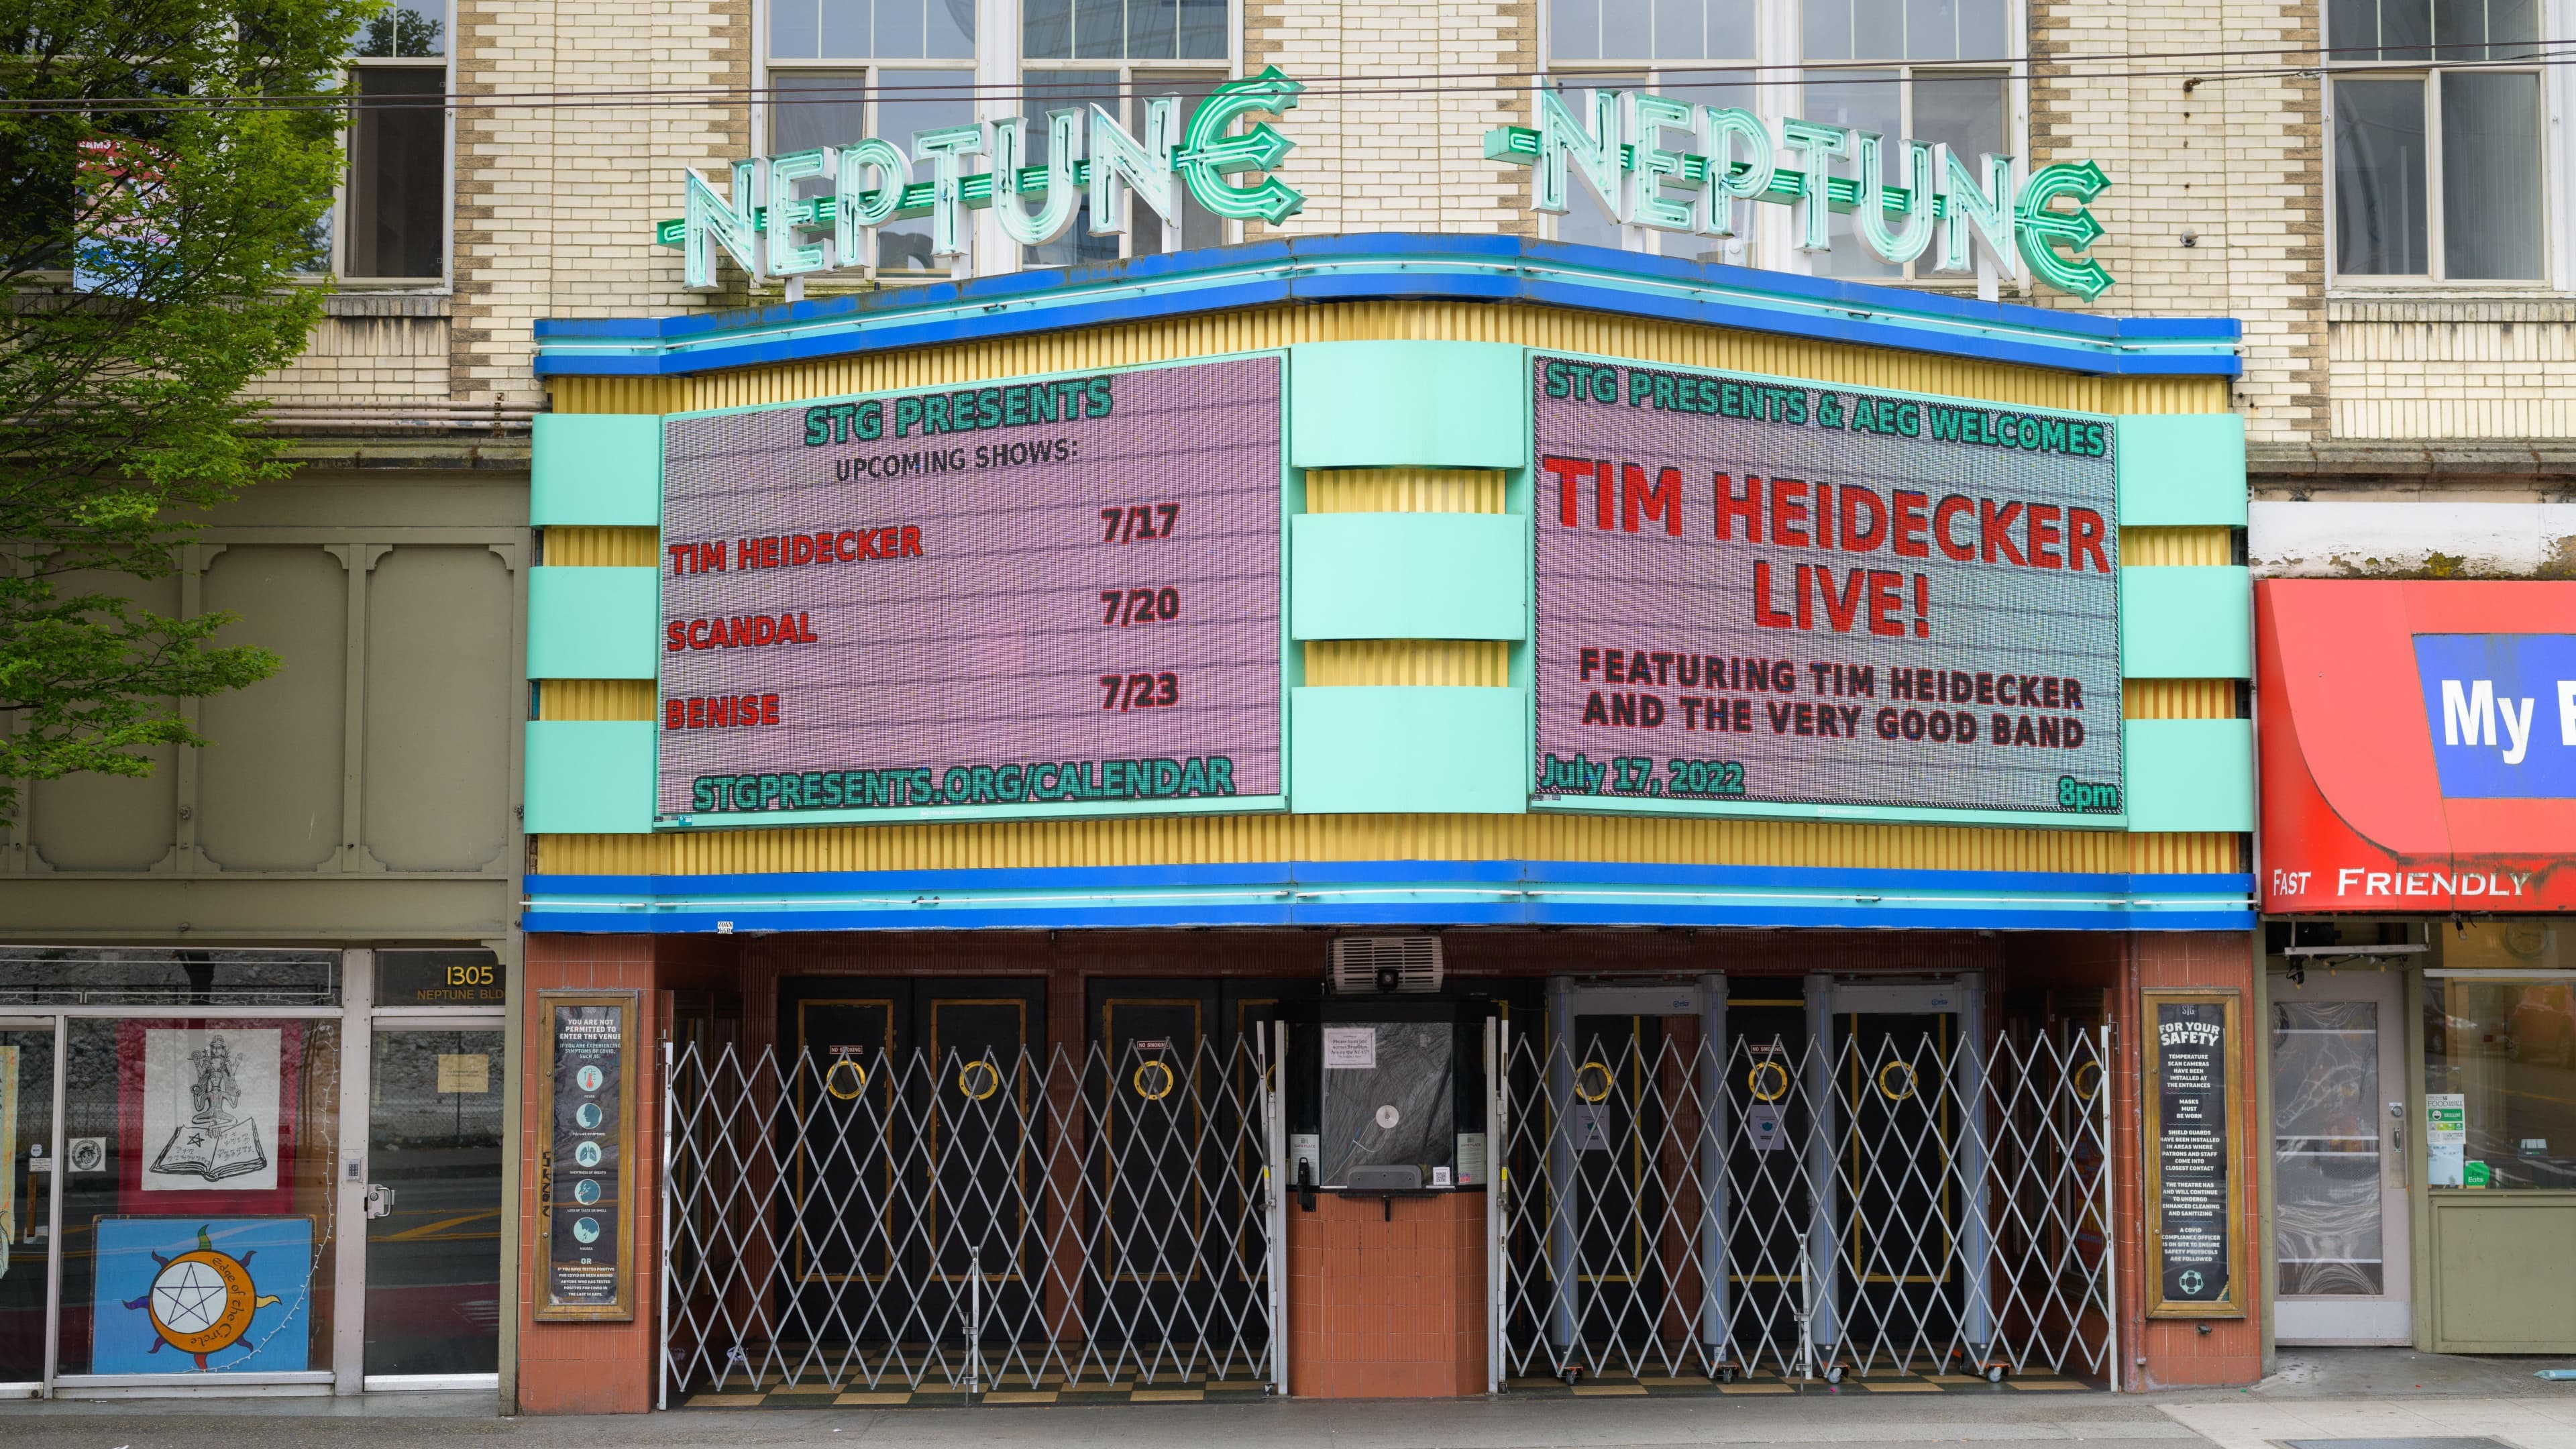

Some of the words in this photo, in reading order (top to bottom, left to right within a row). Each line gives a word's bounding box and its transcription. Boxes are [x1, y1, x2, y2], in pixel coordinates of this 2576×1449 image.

[683, 65, 1308, 290] NEPTUNE
[1531, 78, 2116, 303] NEPTUNE
[804, 400, 882, 447] STG
[896, 376, 1113, 437] PRESENTS
[1544, 361, 1618, 402] STG
[1628, 371, 1809, 425] PRESENTS
[1817, 396, 1844, 429] &
[1852, 400, 1919, 437] AEG
[1929, 407, 2105, 456] WELCOMES
[836, 447, 966, 481] UPCOMING
[975, 439, 1079, 470] SHOWS:
[1100, 504, 1180, 543] 7/17
[1542, 454, 1682, 537] TIM
[1713, 471, 2111, 574] HEIDECKER
[669, 542, 726, 575] TIM
[737, 526, 923, 571] HEIDECKER
[1100, 587, 1180, 626] 7/20
[1753, 559, 1929, 638] LIVE!
[667, 613, 818, 651] SCANDAL
[1099, 674, 1179, 712] 7/23
[1580, 647, 1796, 694] FEATURING
[1809, 662, 1875, 699] TIM
[1890, 667, 2084, 711] HEIDECKER
[665, 694, 781, 730] BENISE
[1582, 692, 1664, 729] AND
[1679, 696, 1752, 733] THE
[1766, 701, 1861, 738] VERY
[1877, 707, 1977, 745] GOOD
[1992, 713, 2084, 749] BAND
[2441, 680, 2534, 765] My
[692, 757, 1235, 811] STGPRESENTS.ORG/CALENDAR
[1541, 754, 1607, 794] July
[1612, 757, 1662, 796] 17,
[1668, 761, 1746, 794] 2022
[2057, 776, 2118, 811] 8pm
[417, 989, 474, 1000] NEPTUNE
[480, 989, 505, 999] BLD
[447, 966, 494, 985] 1305
[2159, 1022, 2183, 1034] FOR
[2186, 1022, 2220, 1035] YOUR
[2161, 1031, 2219, 1046] SAFETY
[213, 1257, 235, 1283] Edge
[230, 1284, 246, 1296] of
[227, 1299, 244, 1322] the
[191, 1323, 232, 1347] Circle
